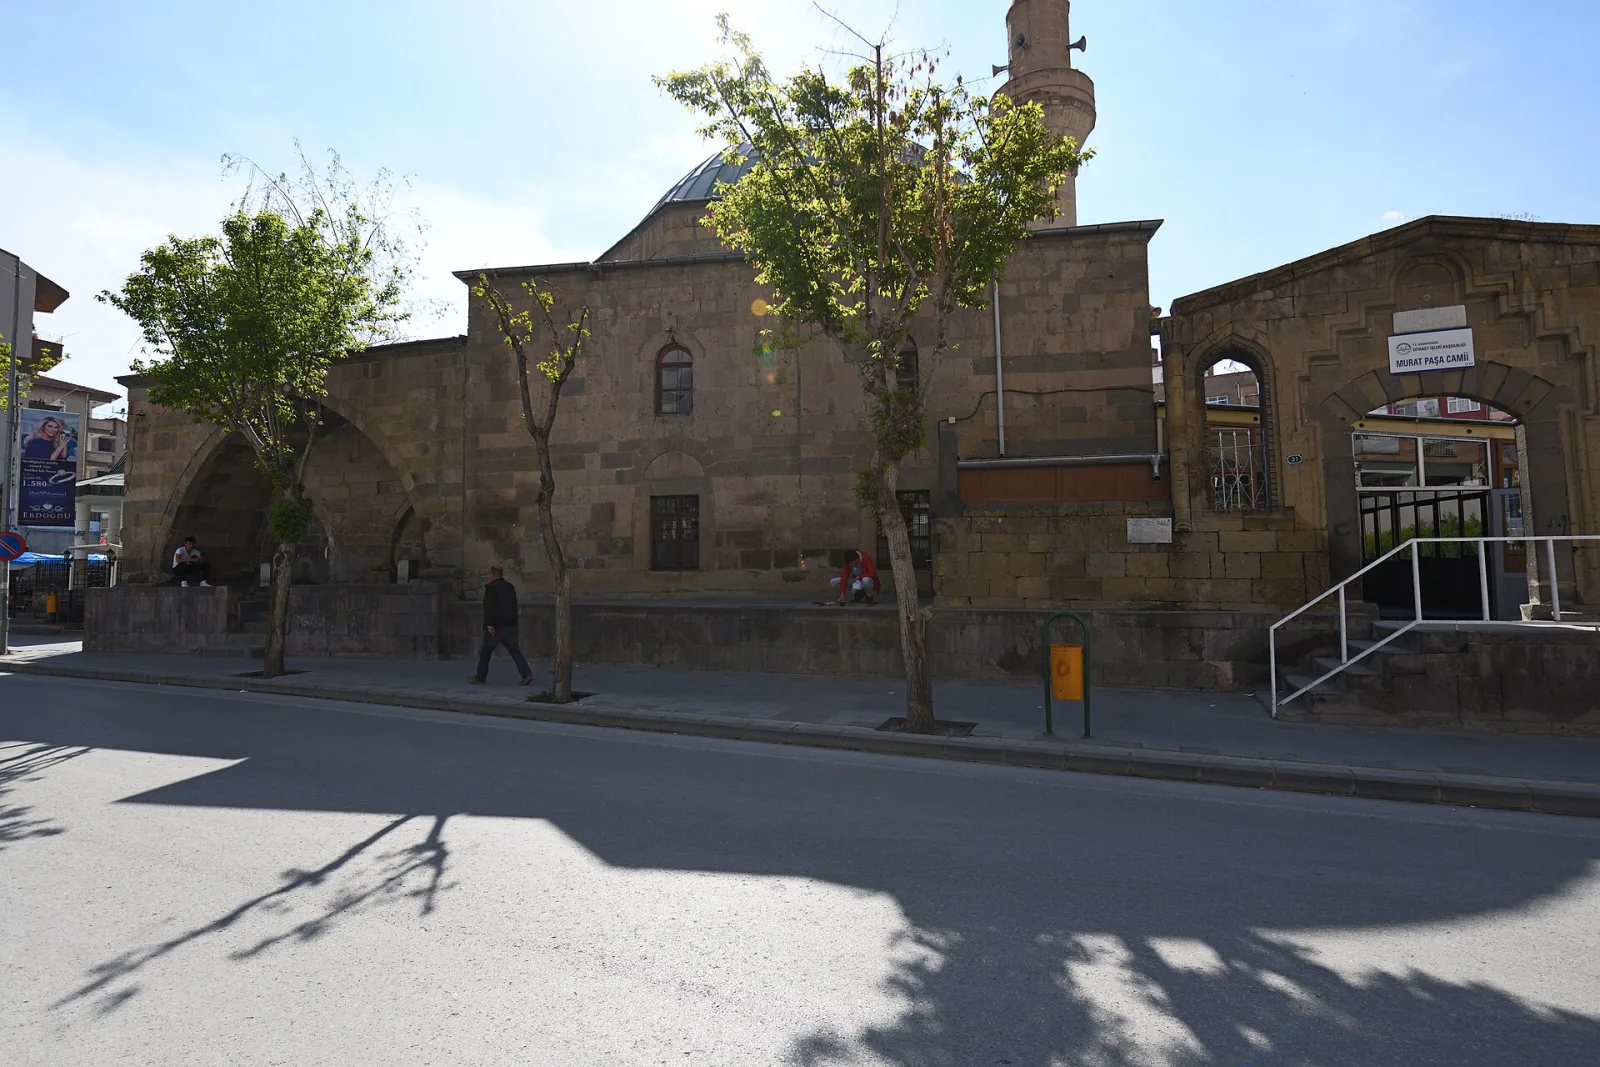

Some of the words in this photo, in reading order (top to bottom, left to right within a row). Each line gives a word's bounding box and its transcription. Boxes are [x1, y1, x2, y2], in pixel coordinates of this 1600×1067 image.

[1396, 358, 1422, 368] MURAT
[1424, 355, 1444, 366] PAŞA
[1446, 352, 1469, 362] CAMİİ
